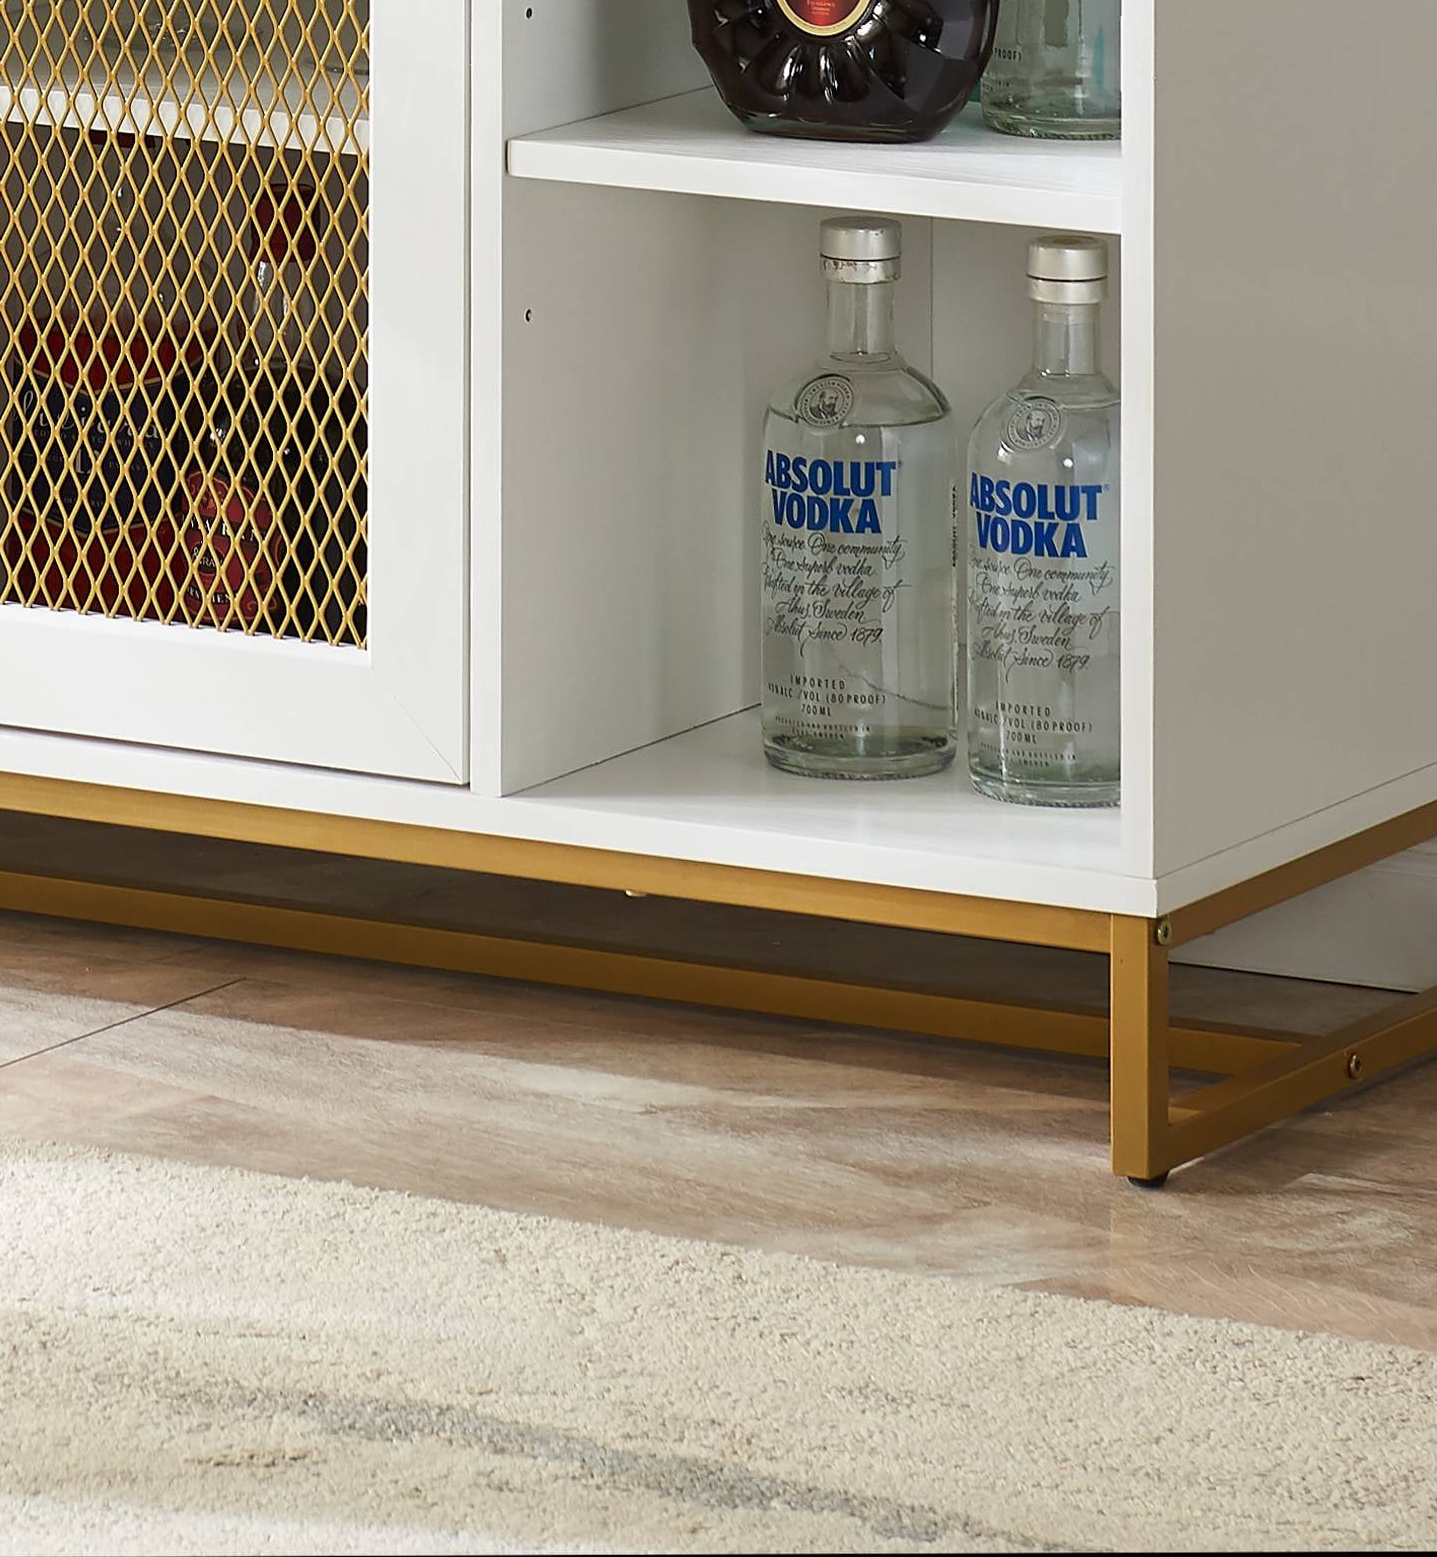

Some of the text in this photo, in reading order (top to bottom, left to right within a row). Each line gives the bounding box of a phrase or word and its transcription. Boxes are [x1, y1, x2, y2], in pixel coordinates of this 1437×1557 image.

[765, 449, 896, 497] ABSOLUT
[772, 488, 882, 534] VODKA
[970, 471, 1102, 521] ABSOLUT
[807, 532, 836, 556] One
[976, 511, 1088, 558] VODKA
[1013, 557, 1042, 581] One
[793, 582, 805, 596] in
[806, 575, 830, 597] the
[832, 575, 881, 610] village
[881, 579, 912, 613] of
[1011, 600, 1037, 623] the
[1038, 601, 1086, 637] village
[1089, 605, 1112, 640] of
[790, 674, 846, 690] IMPORTED
[996, 701, 1051, 716] IMPORTED
